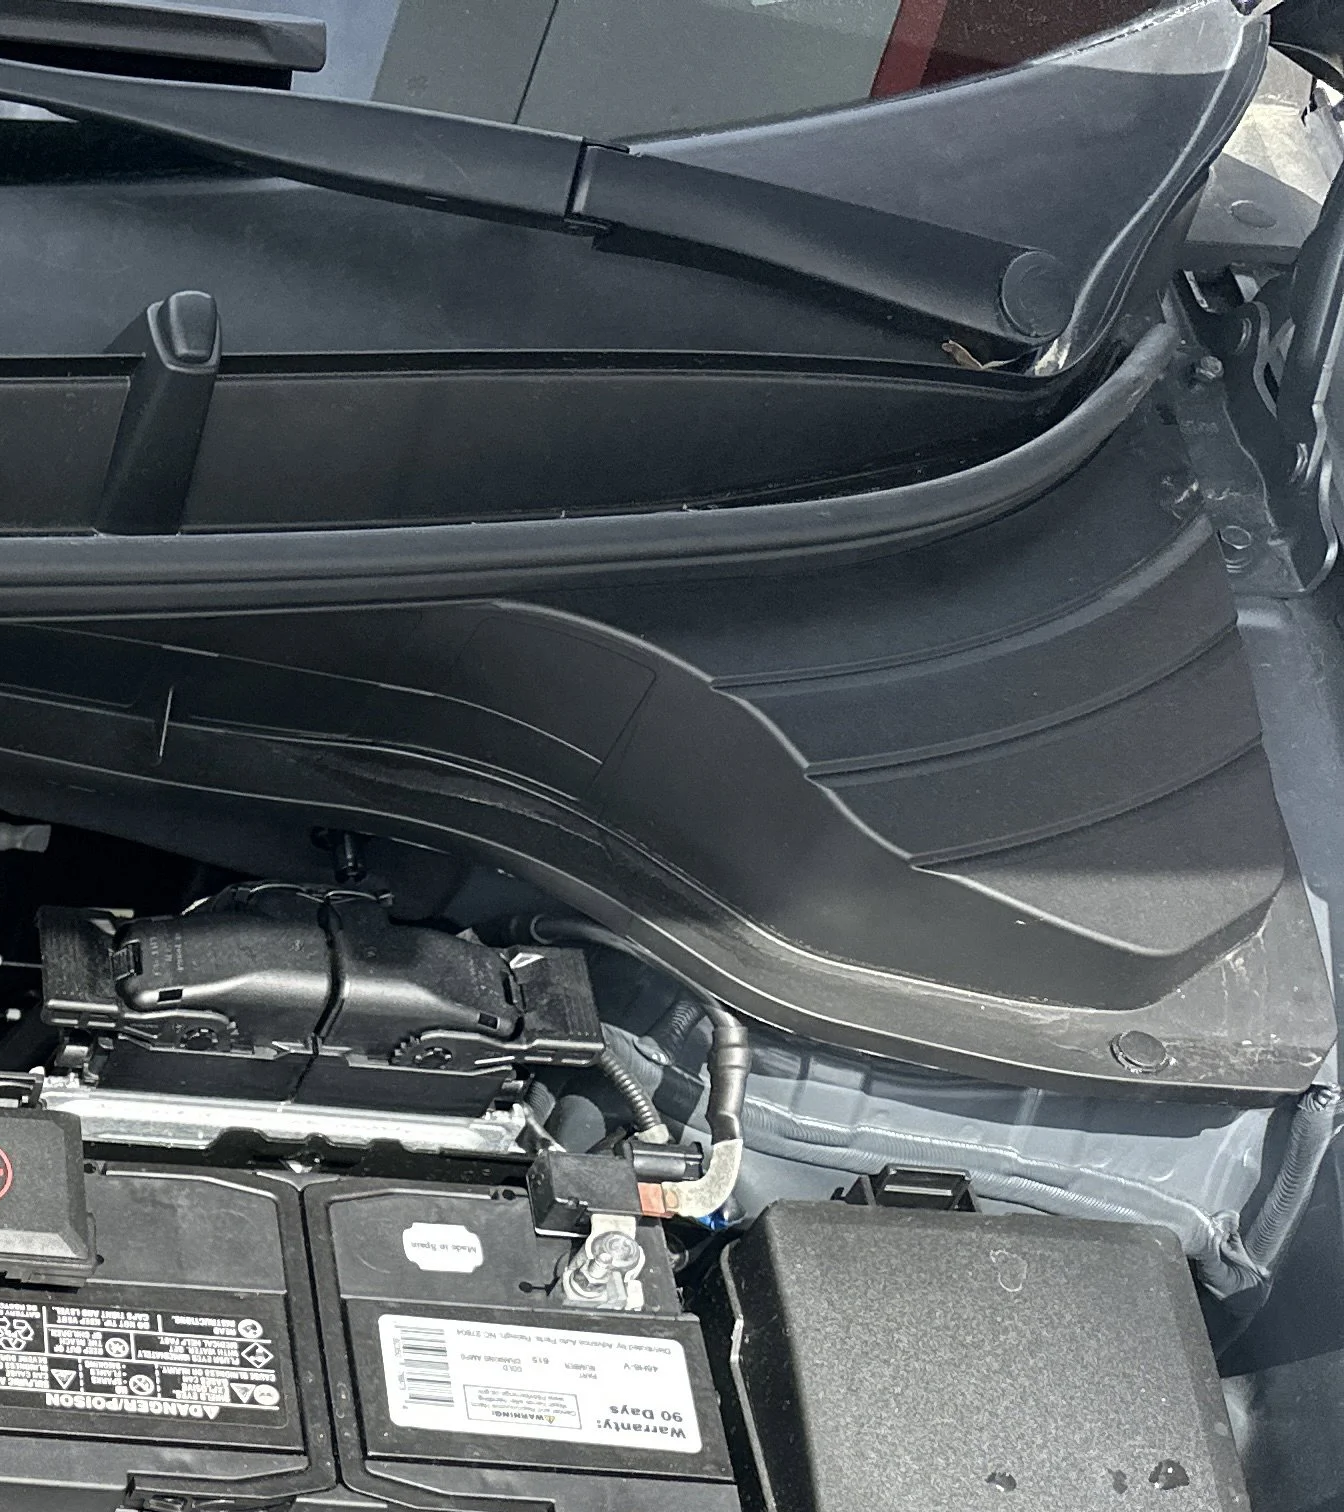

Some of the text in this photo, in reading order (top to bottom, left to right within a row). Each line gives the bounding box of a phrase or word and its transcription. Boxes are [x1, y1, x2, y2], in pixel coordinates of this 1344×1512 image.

[44, 1392, 203, 1419] DANGER/POISON
[609, 1404, 683, 1422] 90 Days
[596, 1418, 686, 1439] Warranty:
